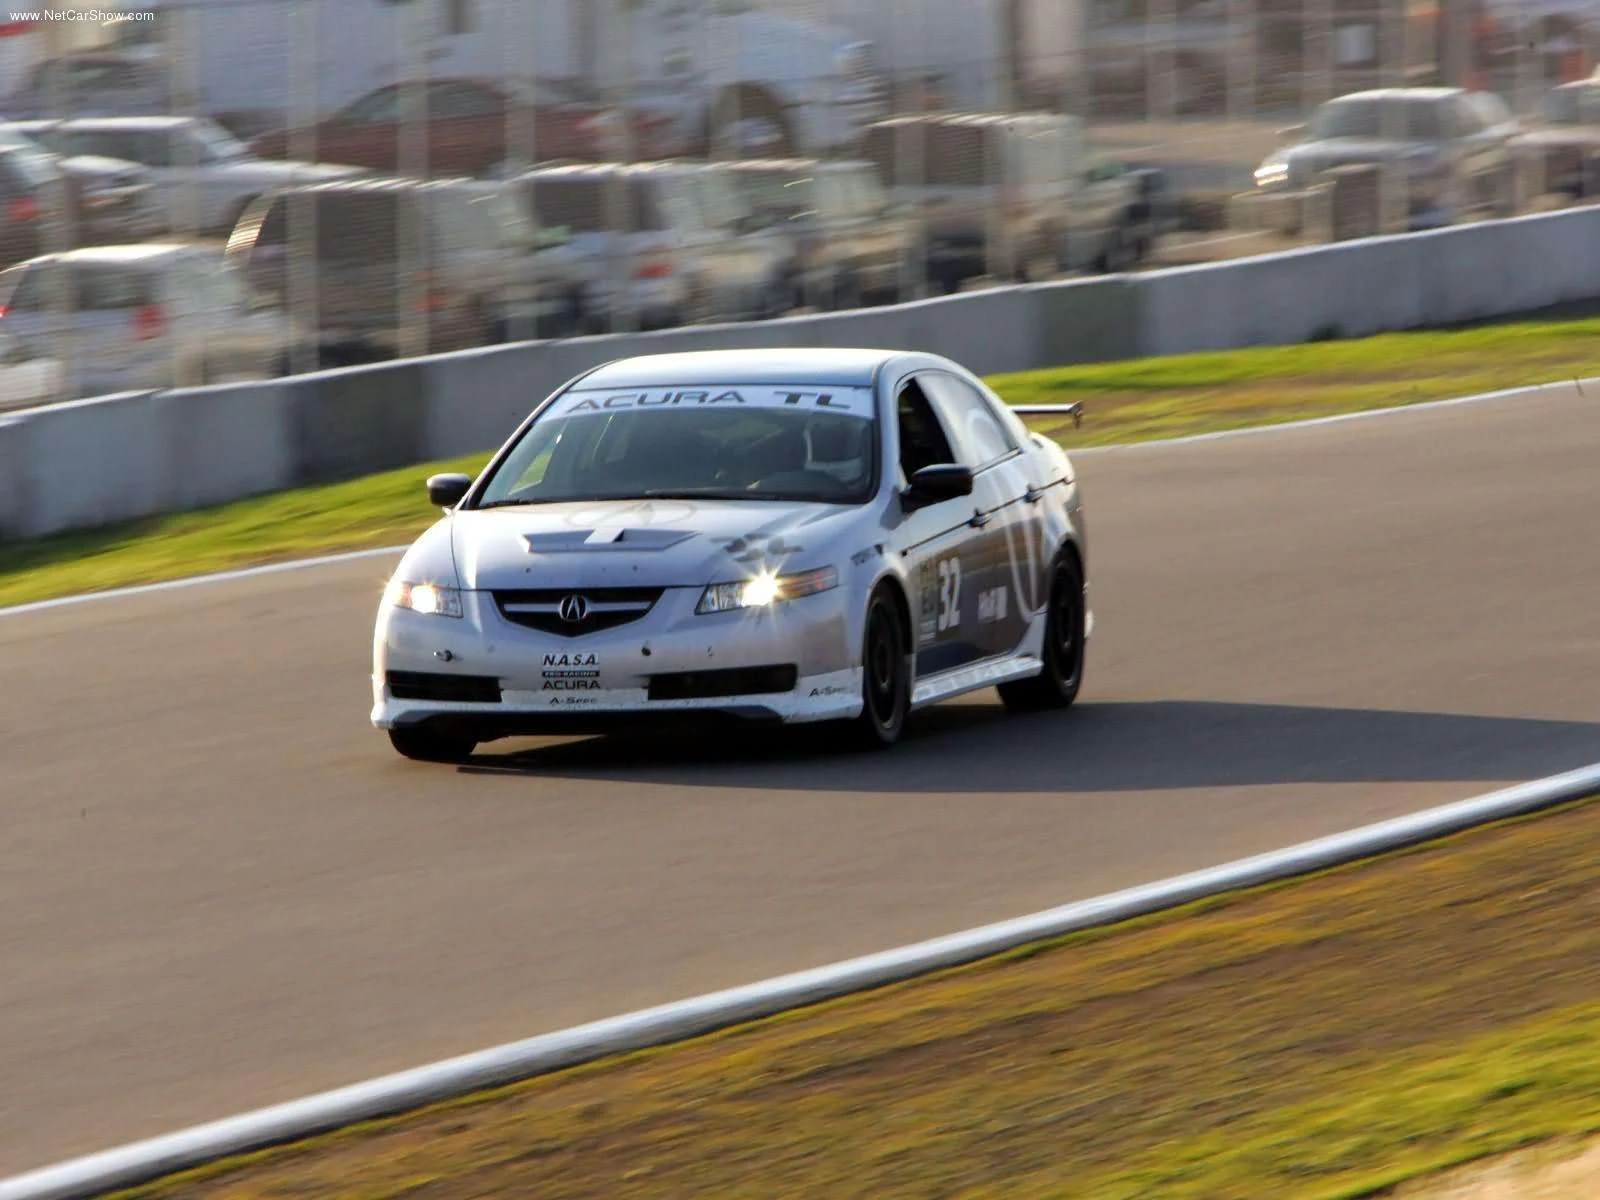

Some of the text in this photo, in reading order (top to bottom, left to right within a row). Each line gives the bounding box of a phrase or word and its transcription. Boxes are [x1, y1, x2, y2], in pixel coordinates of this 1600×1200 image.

[566, 390, 851, 413] ACURA TL
[938, 557, 961, 631] 32
[542, 680, 601, 690] ACURA
